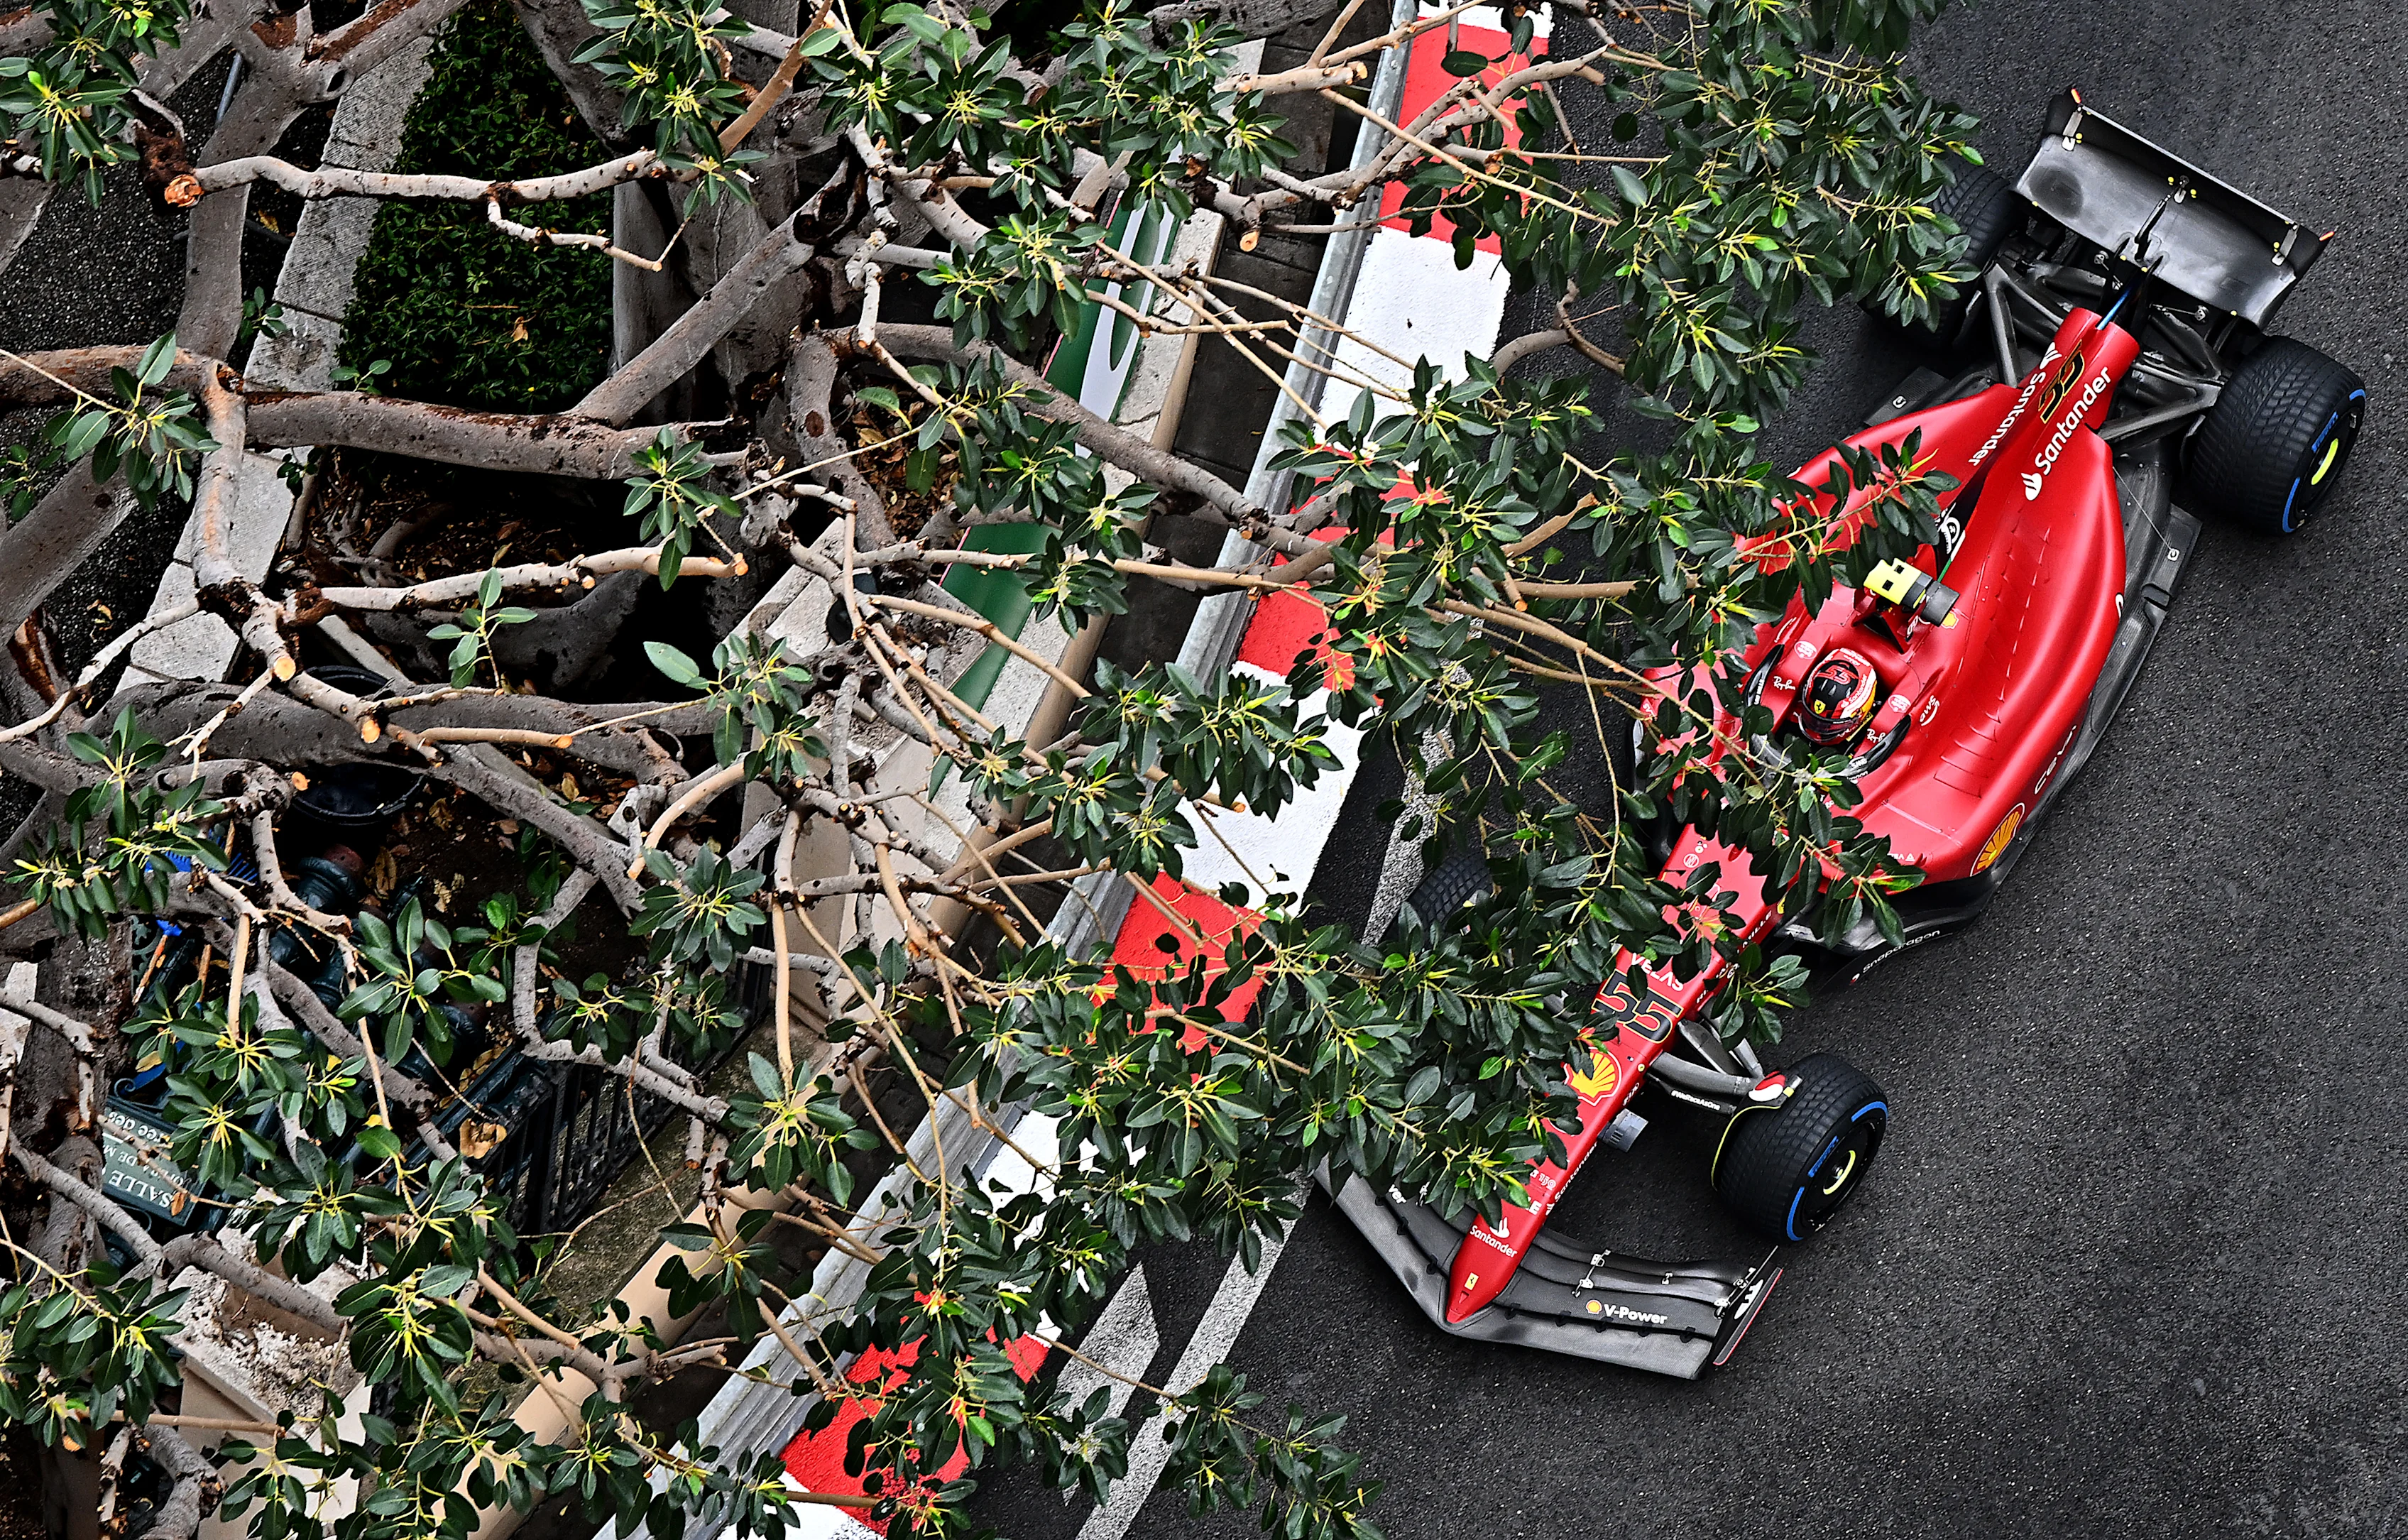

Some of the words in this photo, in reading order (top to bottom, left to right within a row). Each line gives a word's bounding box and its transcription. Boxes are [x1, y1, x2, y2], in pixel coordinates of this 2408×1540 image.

[1968, 371, 2047, 466] Santander
[2035, 366, 2112, 476] Santander
[1862, 929, 1940, 973] Snapdragon
[1591, 968, 1685, 1044] 55
[108, 1169, 173, 1208] SALLE
[1554, 1142, 1598, 1201] Santander
[1470, 1224, 1518, 1258] Santander
[1603, 1304, 1668, 1326] V-Power
